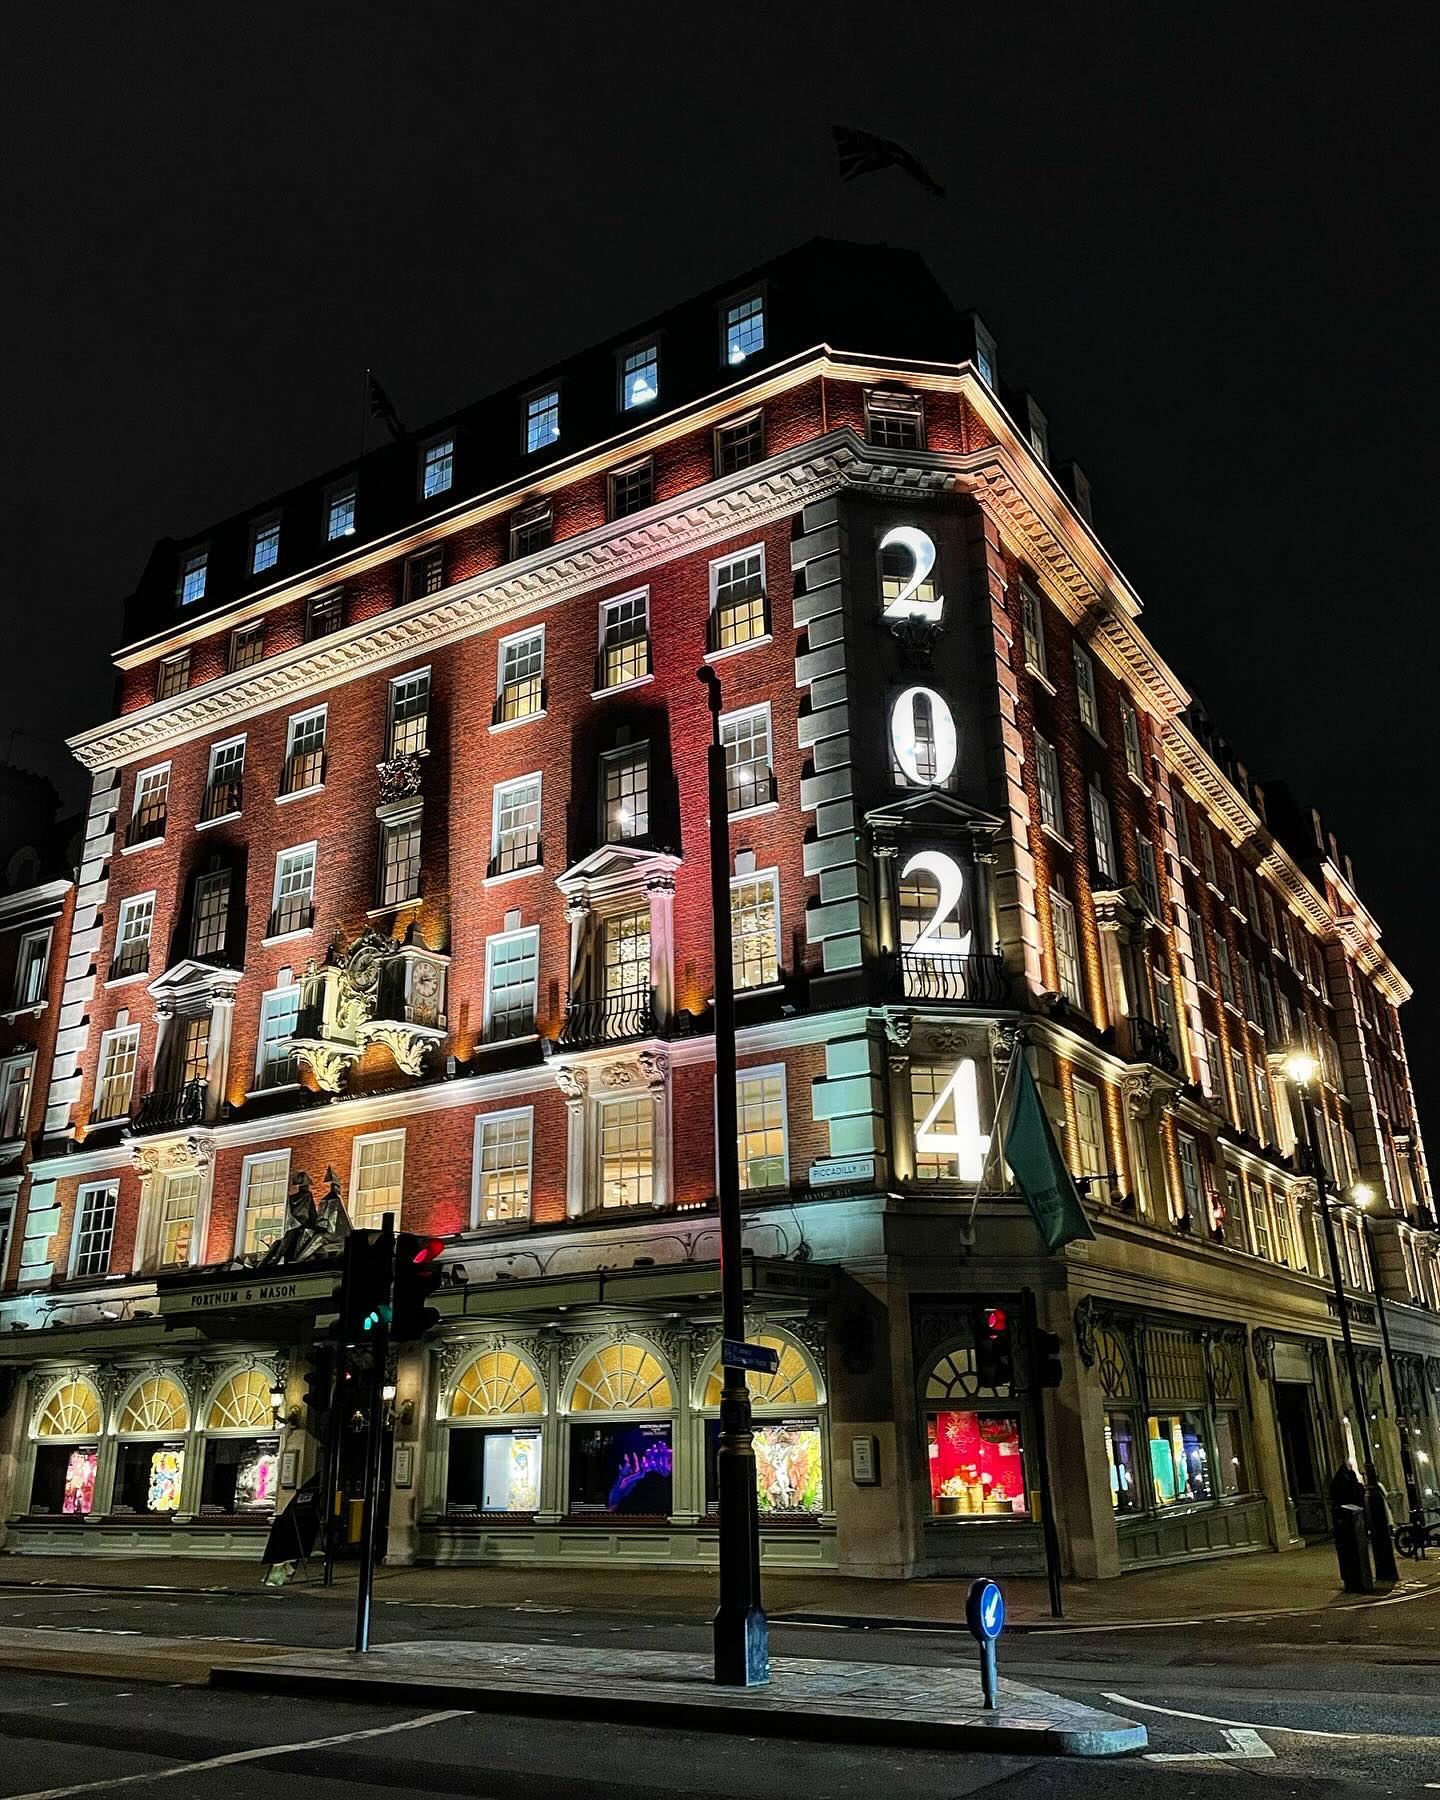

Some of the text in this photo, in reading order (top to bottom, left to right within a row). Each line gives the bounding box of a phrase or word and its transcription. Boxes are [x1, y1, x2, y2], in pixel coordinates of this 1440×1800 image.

[813, 1163, 857, 1177] PICCADILLY
[190, 1284, 297, 1307] FORTNUM & MASON
